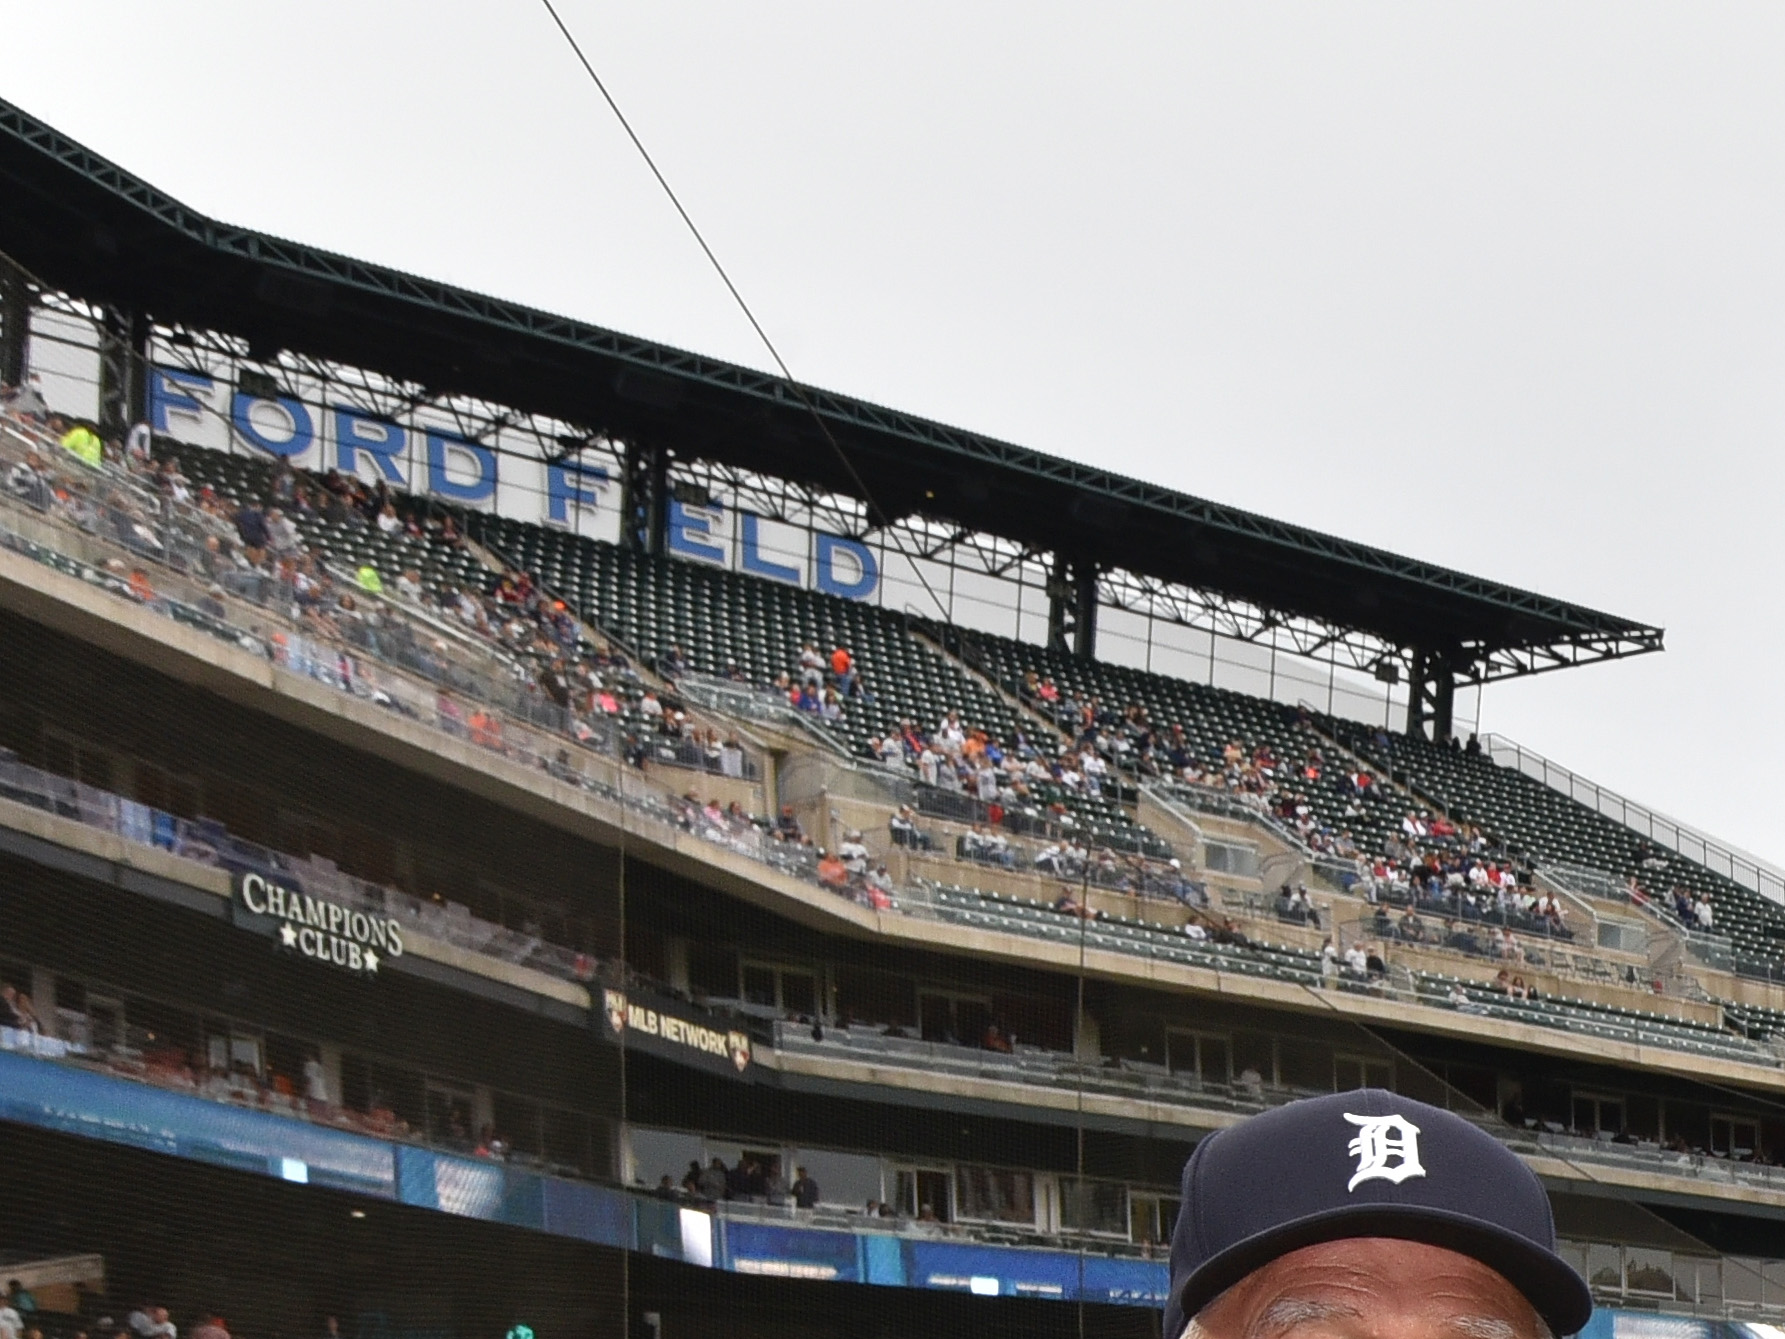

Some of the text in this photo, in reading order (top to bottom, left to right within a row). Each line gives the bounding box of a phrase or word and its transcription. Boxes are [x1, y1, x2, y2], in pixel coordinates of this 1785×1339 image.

[147, 365, 879, 600] FORD FELD
[243, 873, 403, 957] CHAMPIONS
[300, 928, 363, 970] CLUB
[628, 1004, 728, 1057] MLB NETWORK
[1343, 1112, 1427, 1193] D
